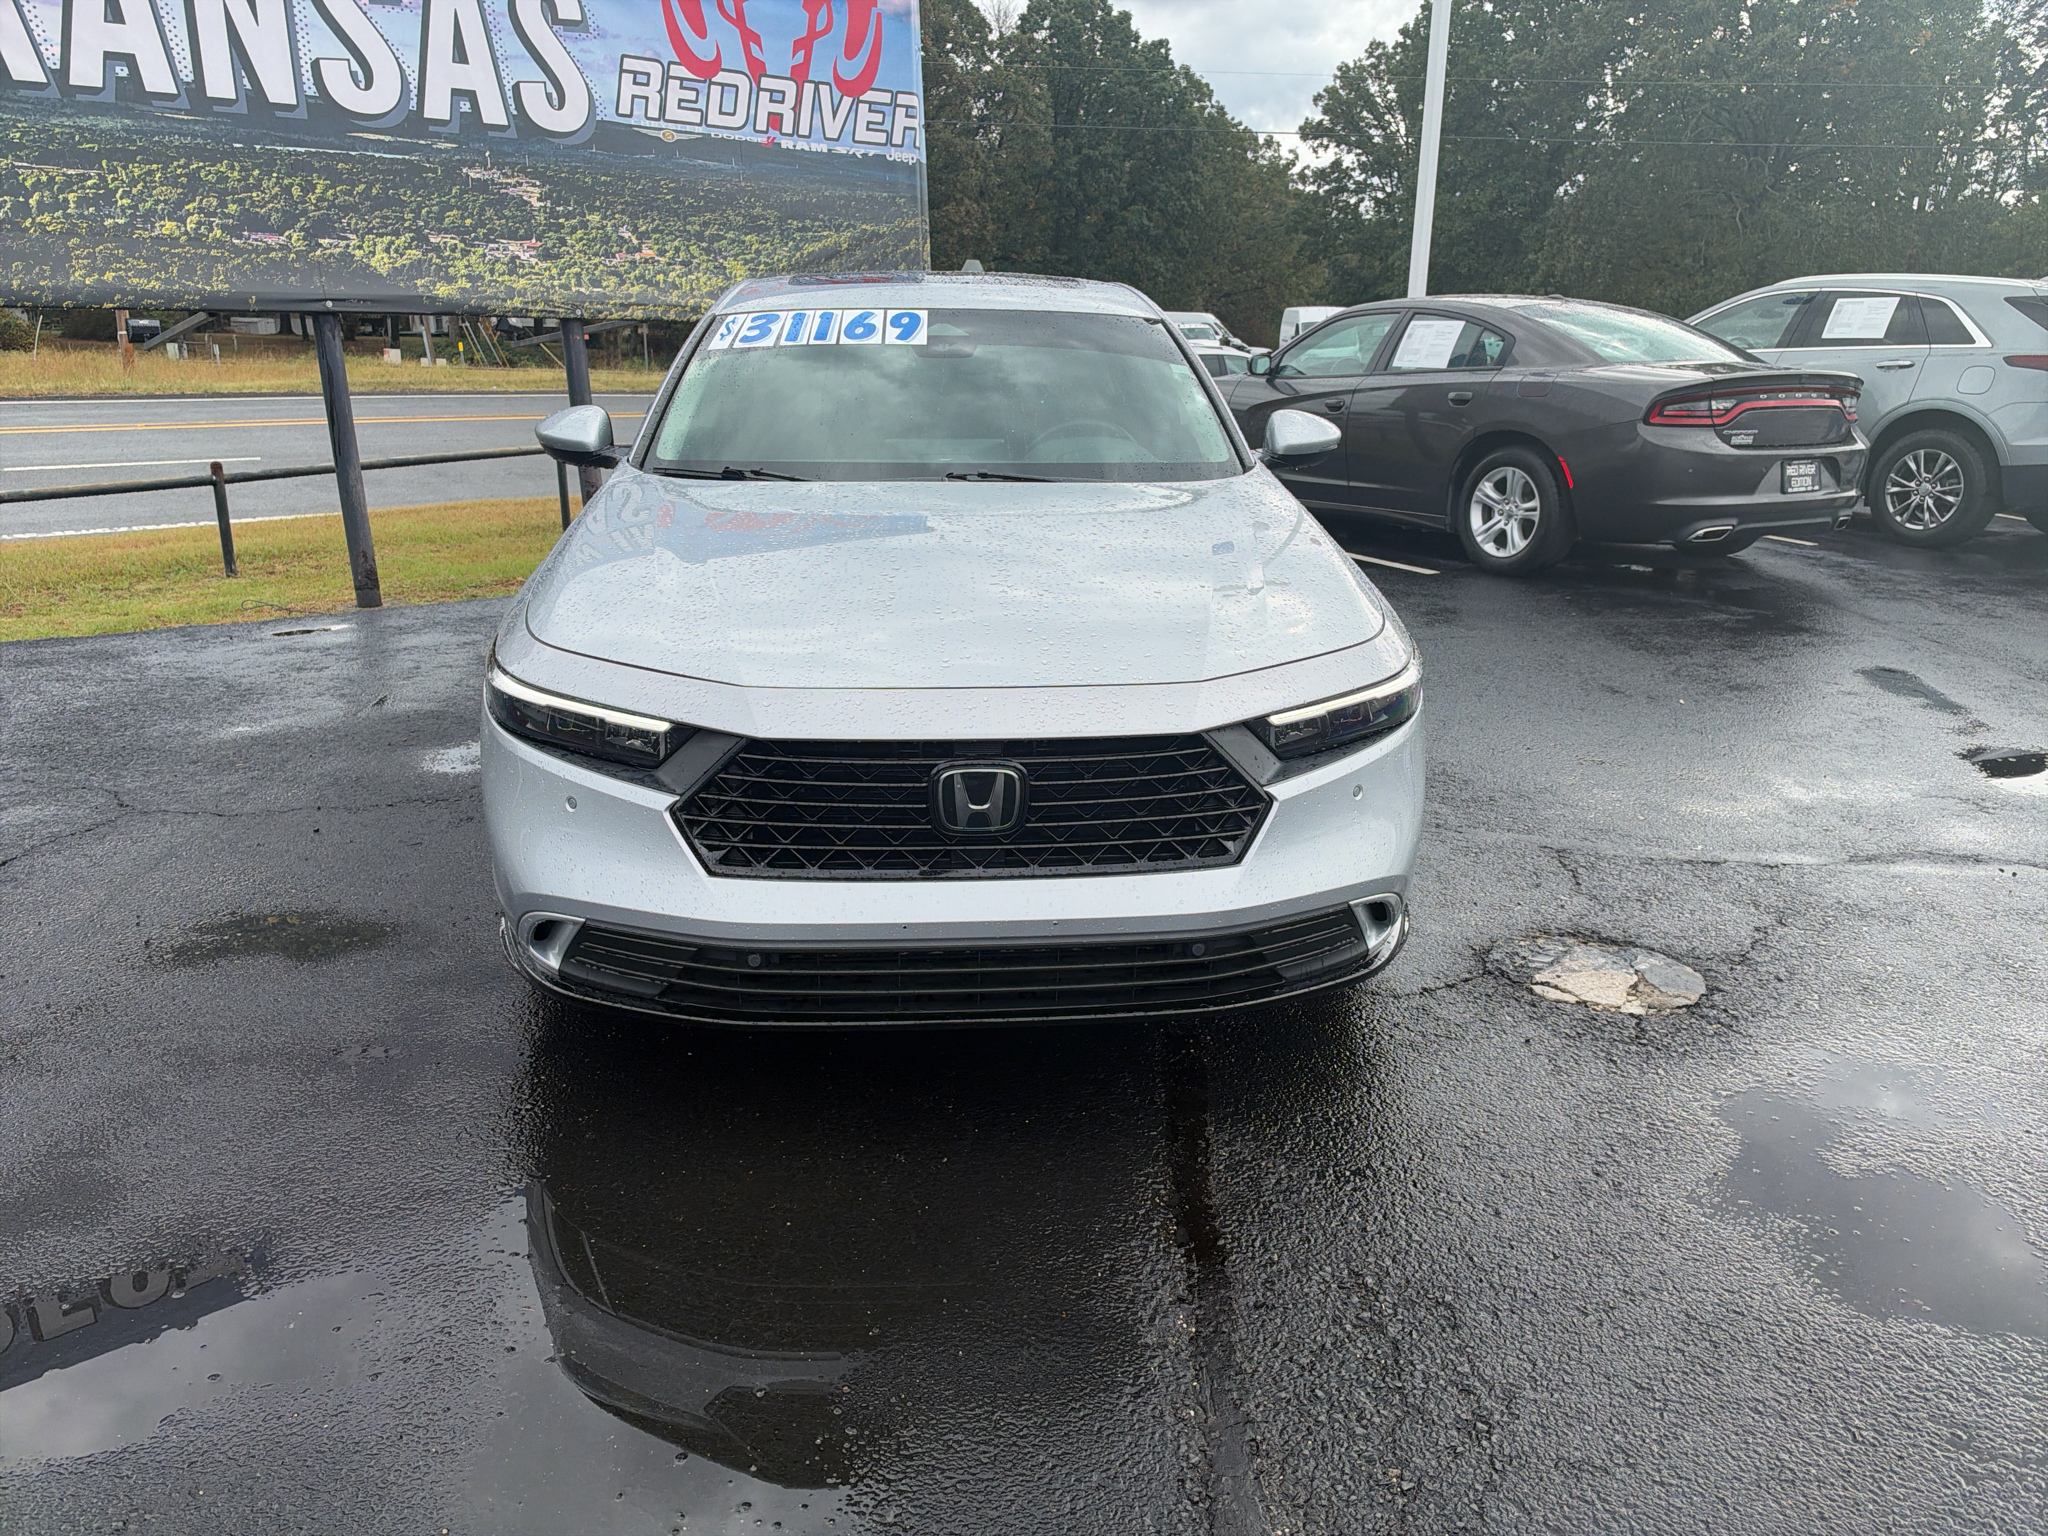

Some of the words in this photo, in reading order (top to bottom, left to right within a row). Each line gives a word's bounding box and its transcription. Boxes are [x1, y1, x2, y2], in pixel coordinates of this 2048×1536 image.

[0, 0, 595, 138] ANSAS
[710, 132, 769, 144] DODGE
[780, 139, 829, 154] RAM
[831, 146, 882, 159] SRT
[886, 147, 918, 166] Jeep
